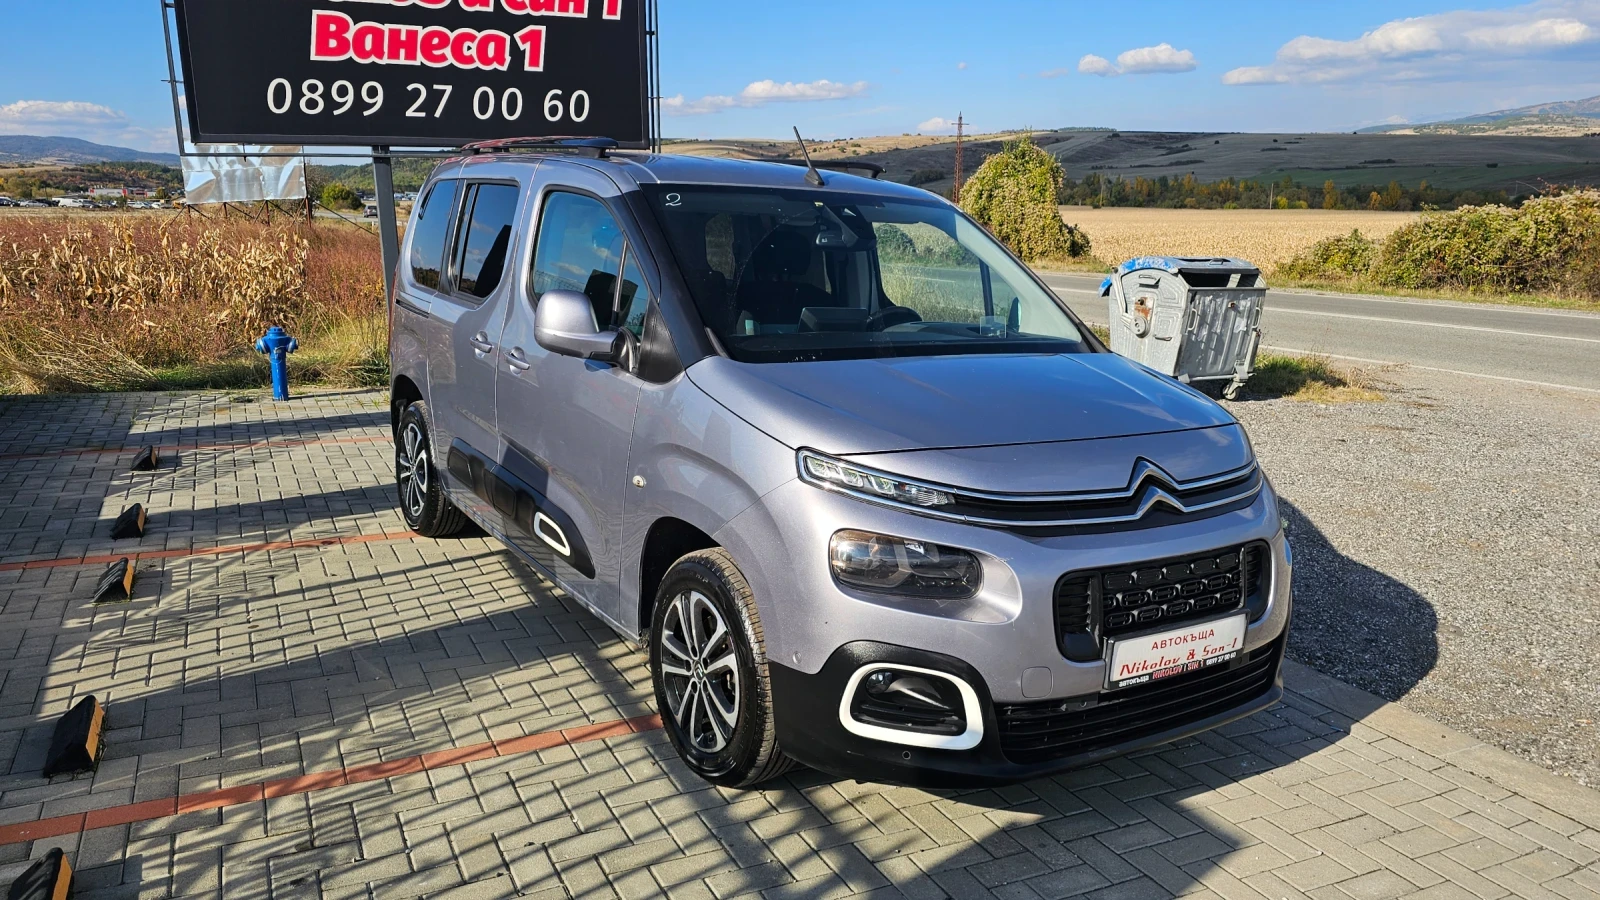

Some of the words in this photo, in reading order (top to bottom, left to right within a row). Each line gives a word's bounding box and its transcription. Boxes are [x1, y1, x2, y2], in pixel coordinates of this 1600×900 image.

[310, 10, 511, 71] Ванеса
[513, 25, 546, 72] 1
[266, 77, 384, 117] 0899
[405, 83, 453, 118] 27
[472, 86, 523, 121] 00
[543, 88, 590, 123] 60
[665, 192, 682, 206] 2
[1151, 628, 1215, 651] АВТОКЪЩА
[1119, 655, 1181, 676] Nikolov
[1186, 648, 1196, 661] &
